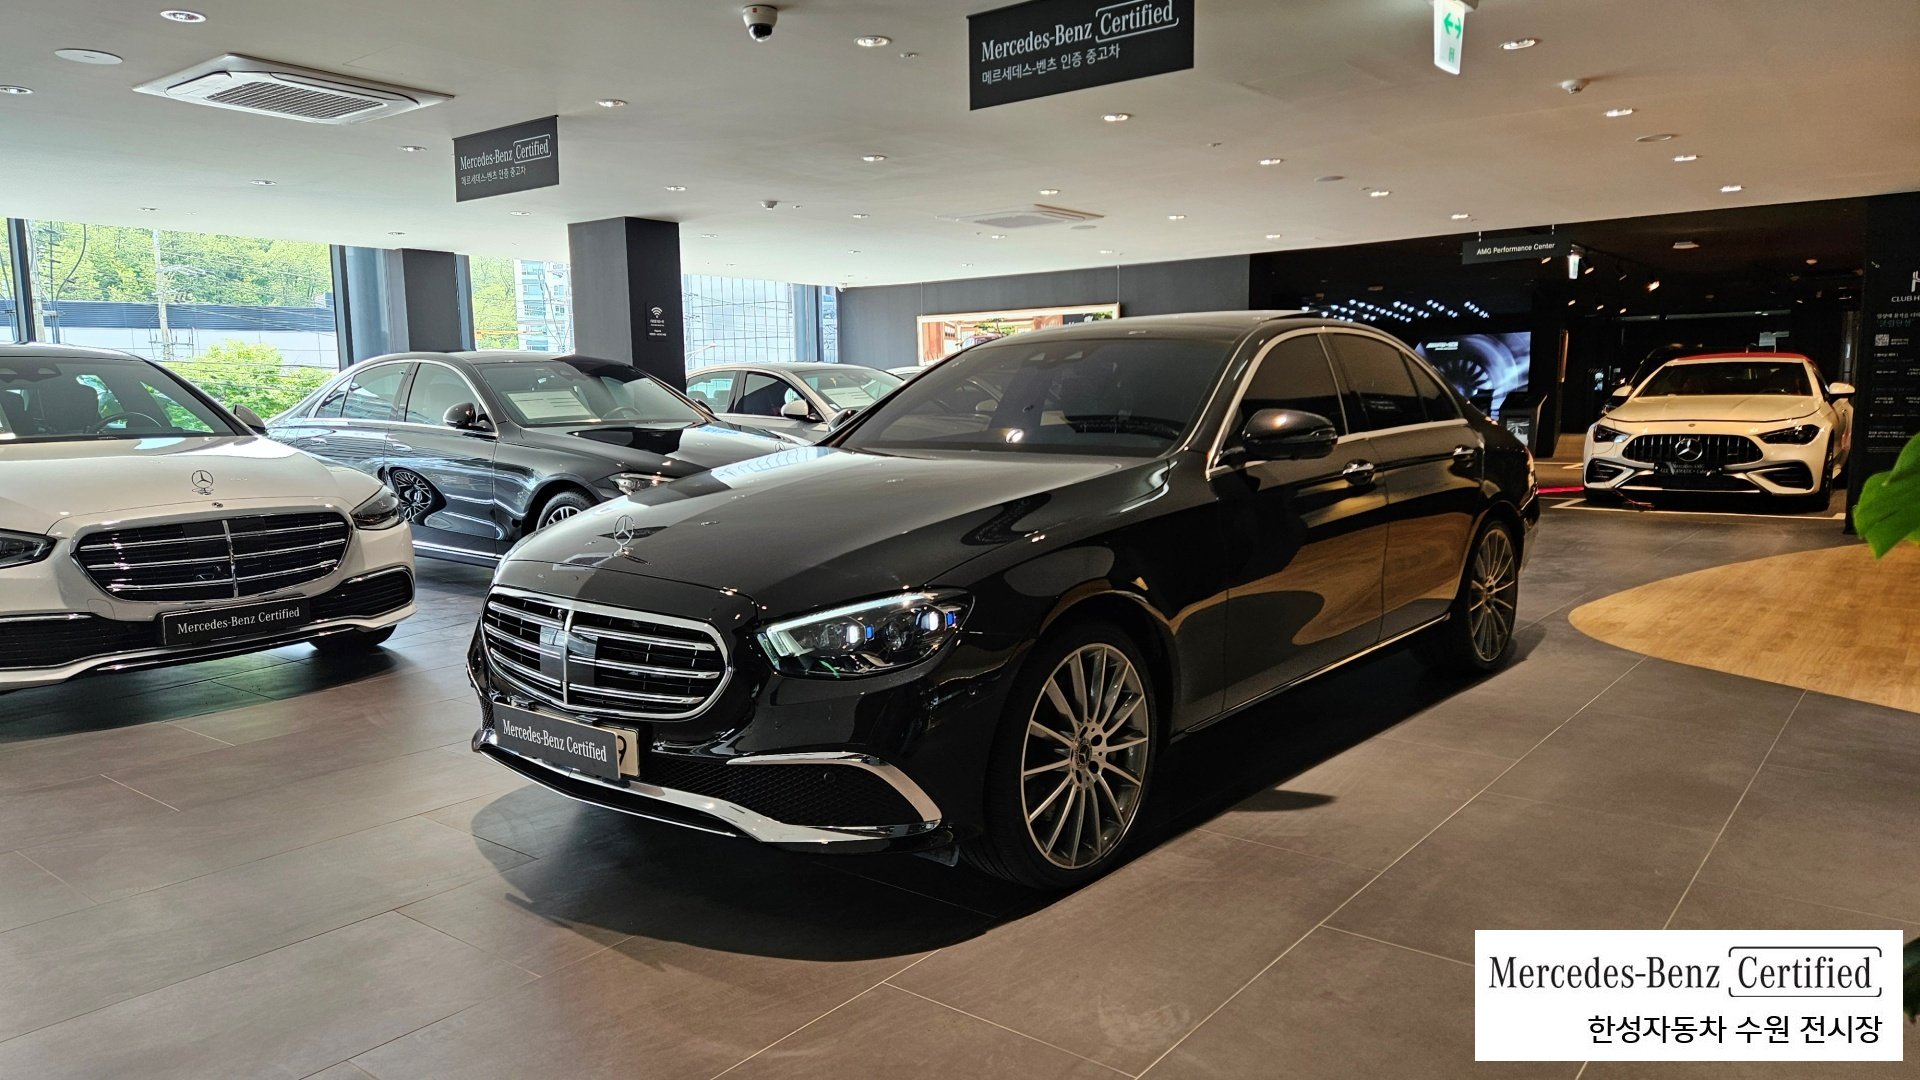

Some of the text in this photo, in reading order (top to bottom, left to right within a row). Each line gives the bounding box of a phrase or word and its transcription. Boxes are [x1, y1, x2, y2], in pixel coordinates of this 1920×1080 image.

[981, 0, 1174, 62] Mercedes-Benz Certified
[982, 43, 1120, 84] 메르세데스-벤츠 인증 중고차
[460, 139, 549, 170] Mercedes-Benz Certified
[1493, 245, 1533, 254] Performance
[1533, 243, 1556, 251] Center
[1891, 295, 1913, 303] CLUB
[177, 607, 300, 635] Mercedes-Benz Certified
[502, 719, 607, 763] Mercedes-Benz Certified
